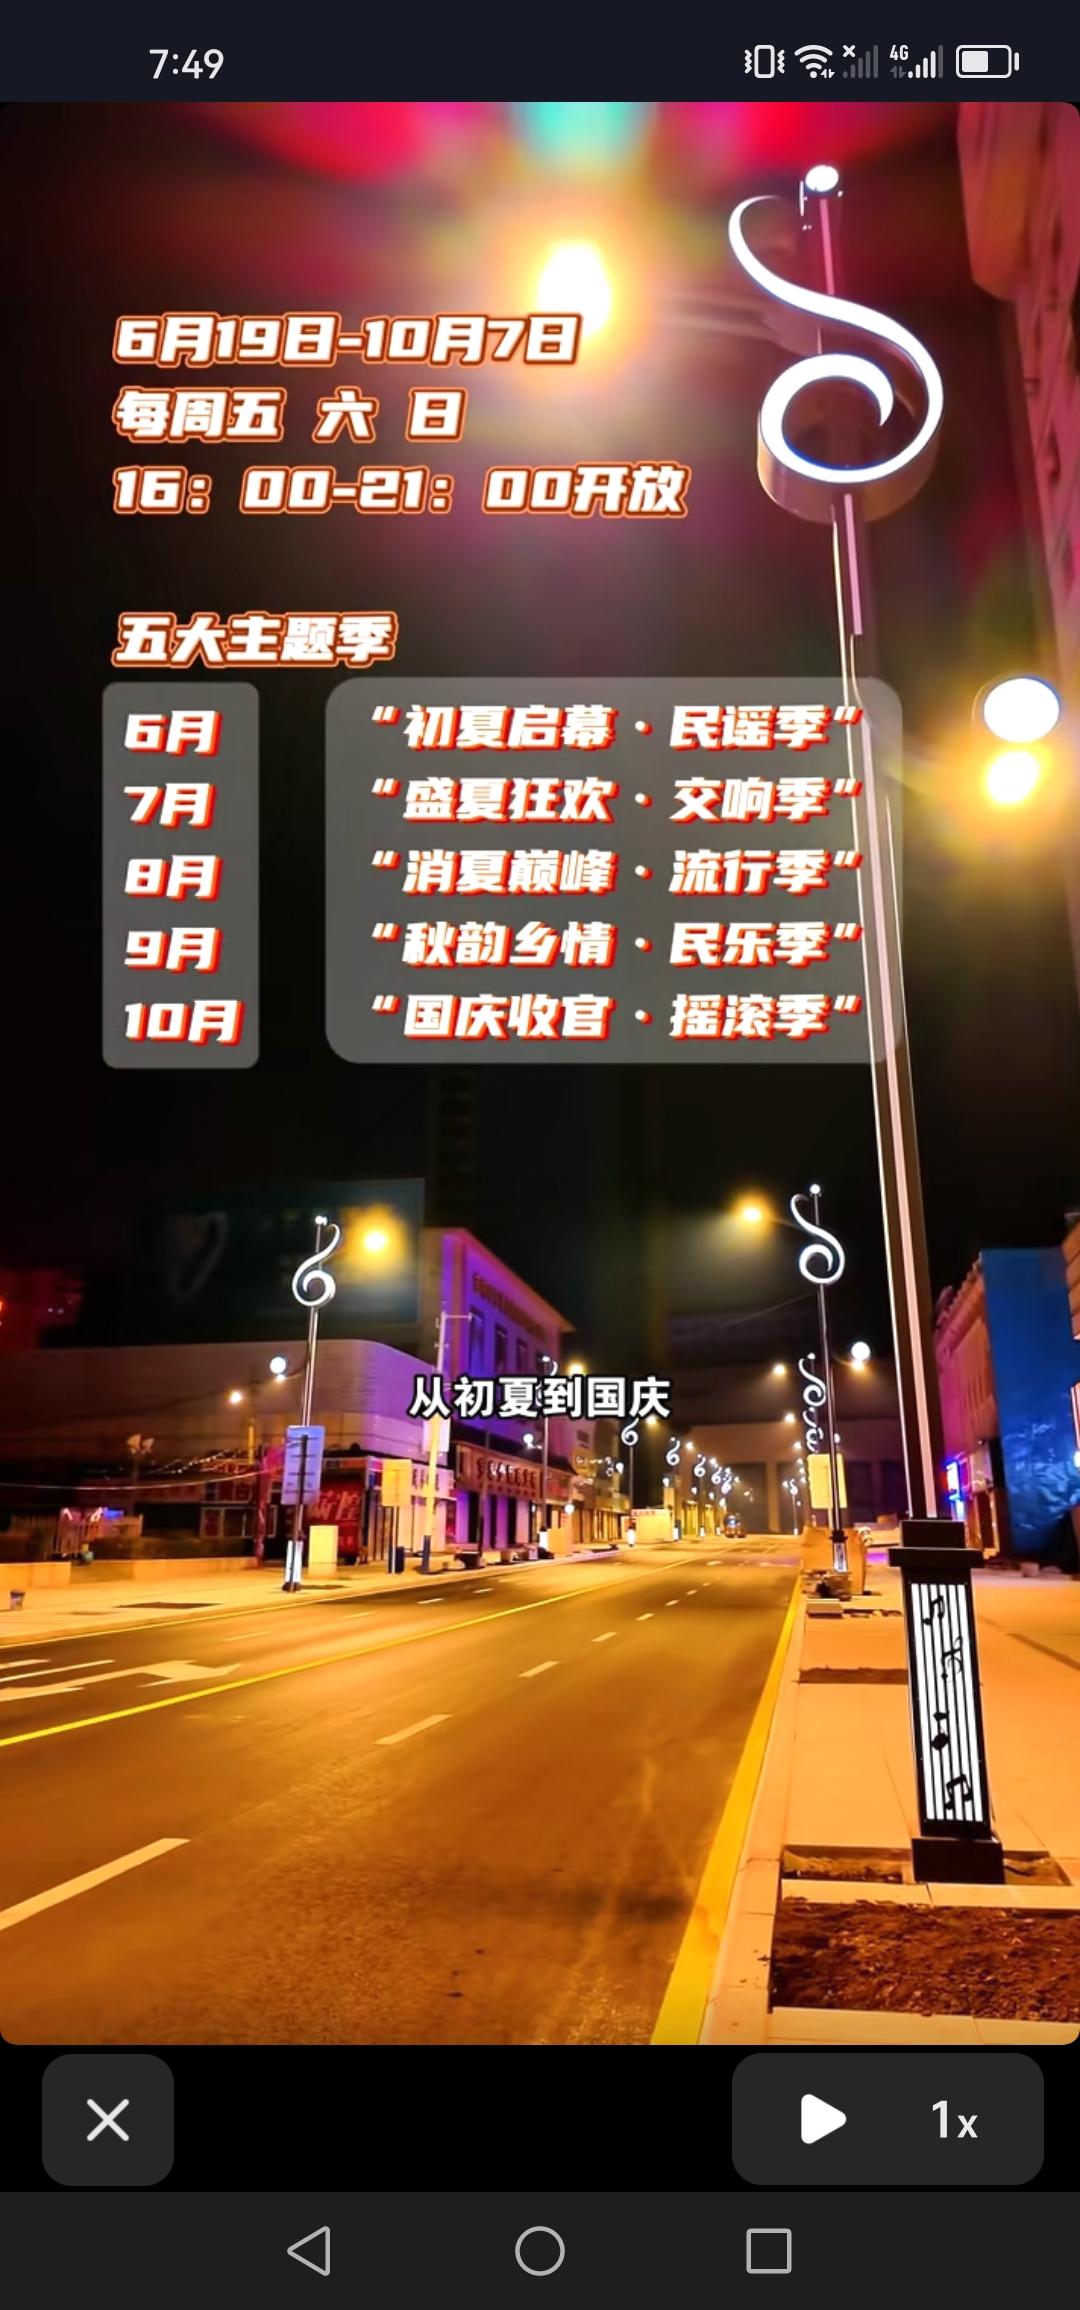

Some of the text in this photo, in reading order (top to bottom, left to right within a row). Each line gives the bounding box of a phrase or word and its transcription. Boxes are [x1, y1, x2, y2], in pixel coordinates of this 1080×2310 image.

[149, 48, 224, 80] 7:49
[889, 44, 909, 61] 4G
[932, 2100, 978, 2138] 1x
